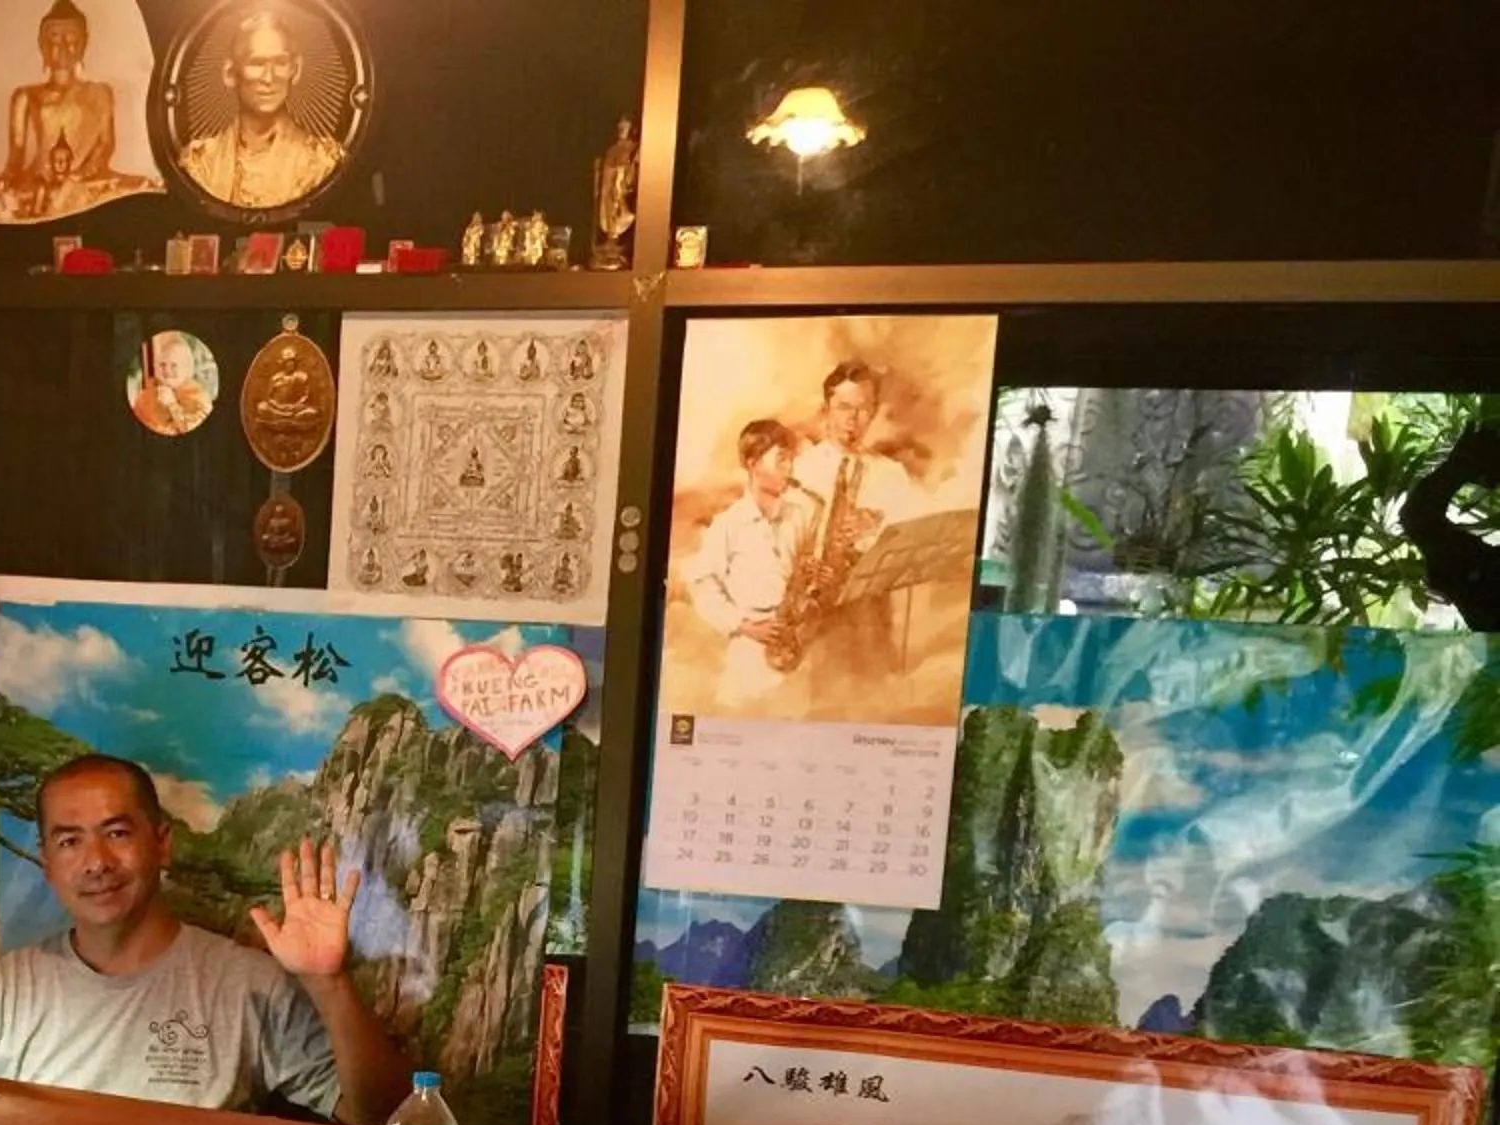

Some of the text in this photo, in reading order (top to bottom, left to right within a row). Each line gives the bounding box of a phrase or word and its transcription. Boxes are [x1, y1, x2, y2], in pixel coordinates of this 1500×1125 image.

[170, 624, 353, 688] 迎客松
[743, 1065, 890, 1102] 八駿雄風
